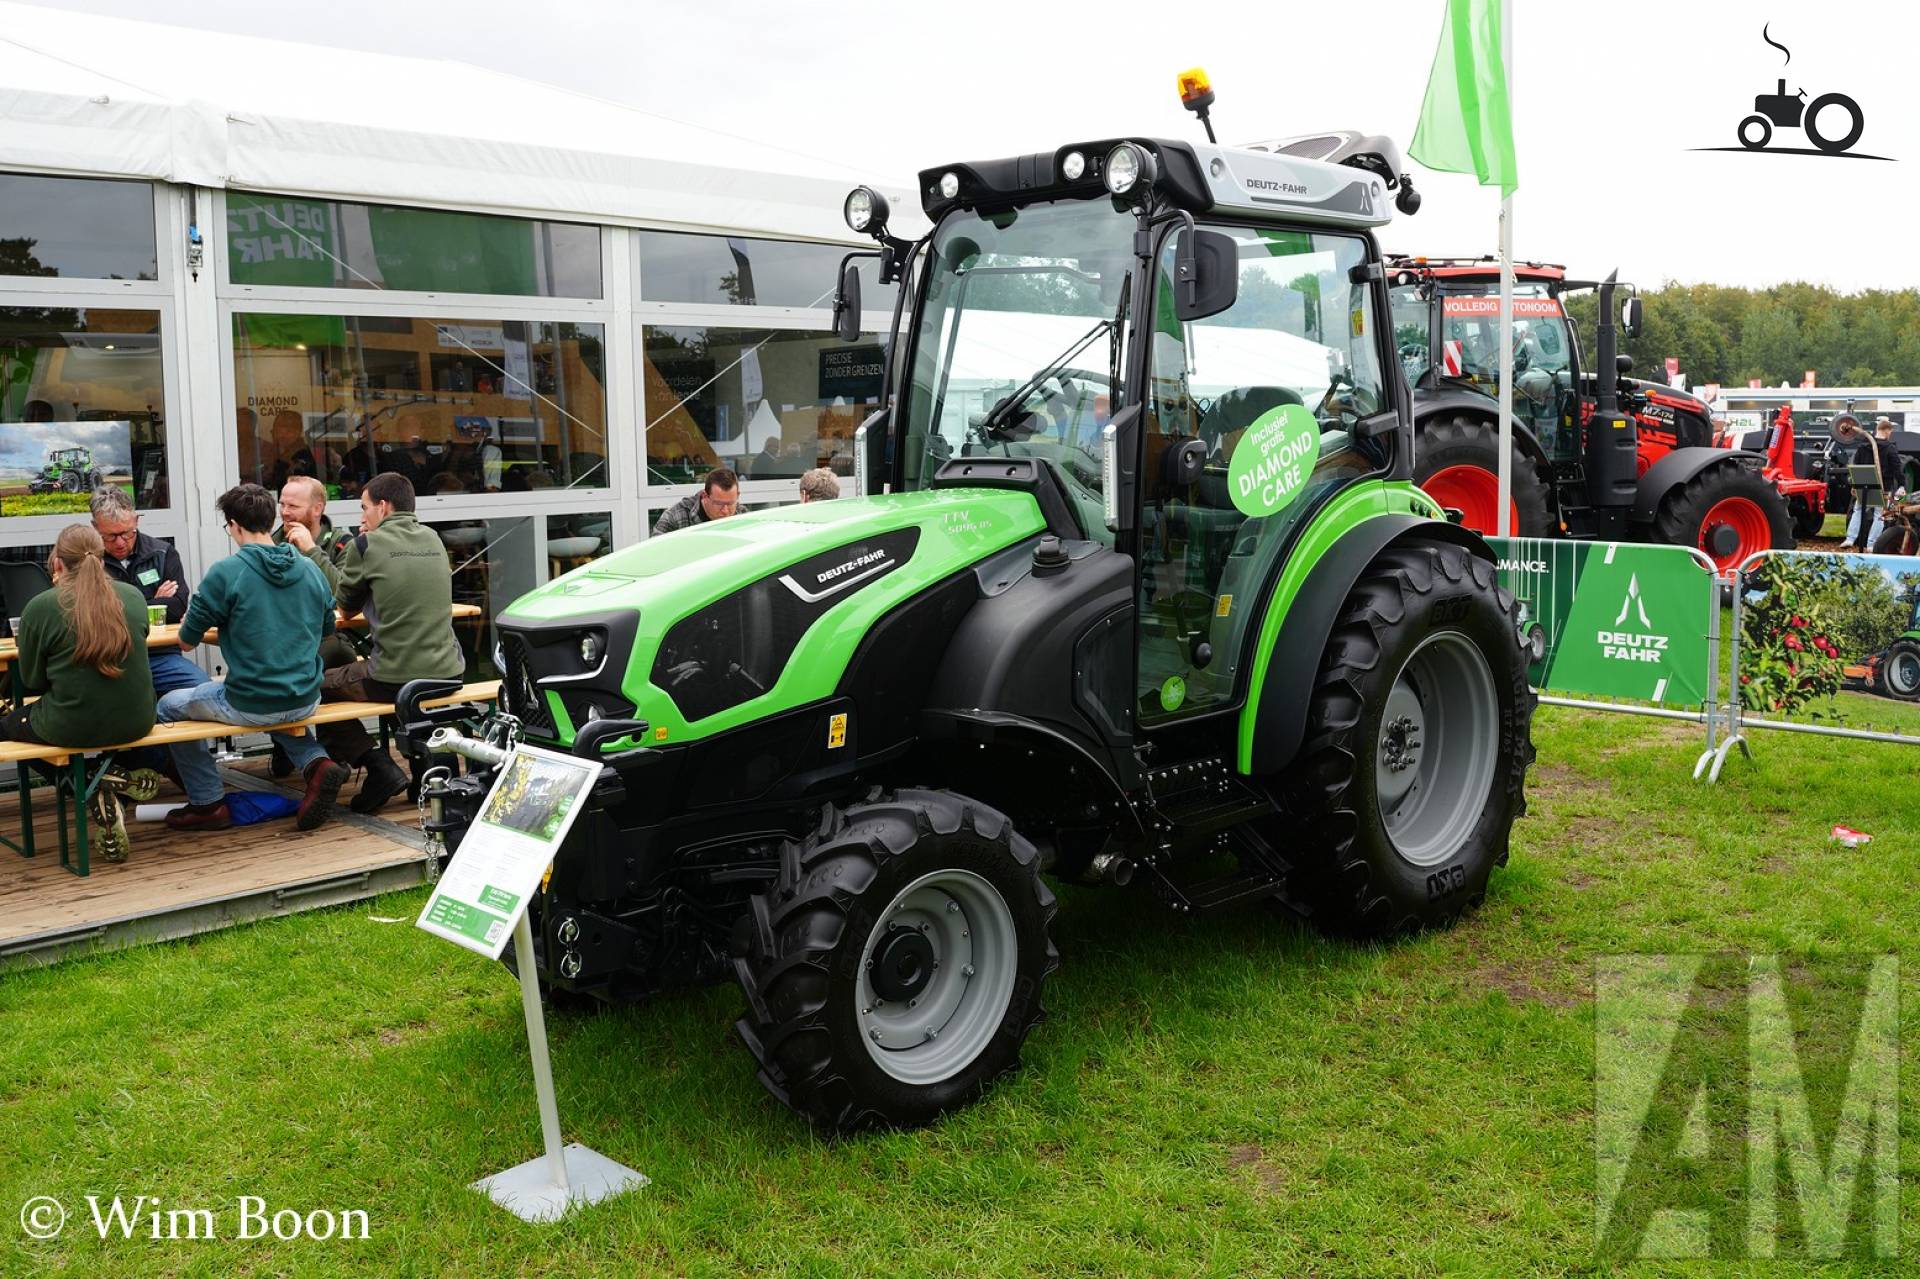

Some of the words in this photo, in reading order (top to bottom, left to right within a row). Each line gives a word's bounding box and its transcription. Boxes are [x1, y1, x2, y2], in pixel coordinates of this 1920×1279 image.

[1246, 178, 1307, 194] DEUTZ-FAHR
[1444, 302, 1498, 312] VOLLEDIG
[1511, 303, 1557, 313] TONOOM
[247, 396, 298, 407] DIAMOND
[1260, 430, 1286, 458] gratis
[1238, 431, 1312, 497] DIAMOND
[1262, 464, 1302, 507] CARE
[816, 549, 886, 584] DEUTZ-FAHR
[1597, 630, 1669, 650] DEUTZ
[1603, 646, 1662, 664] FAHR
